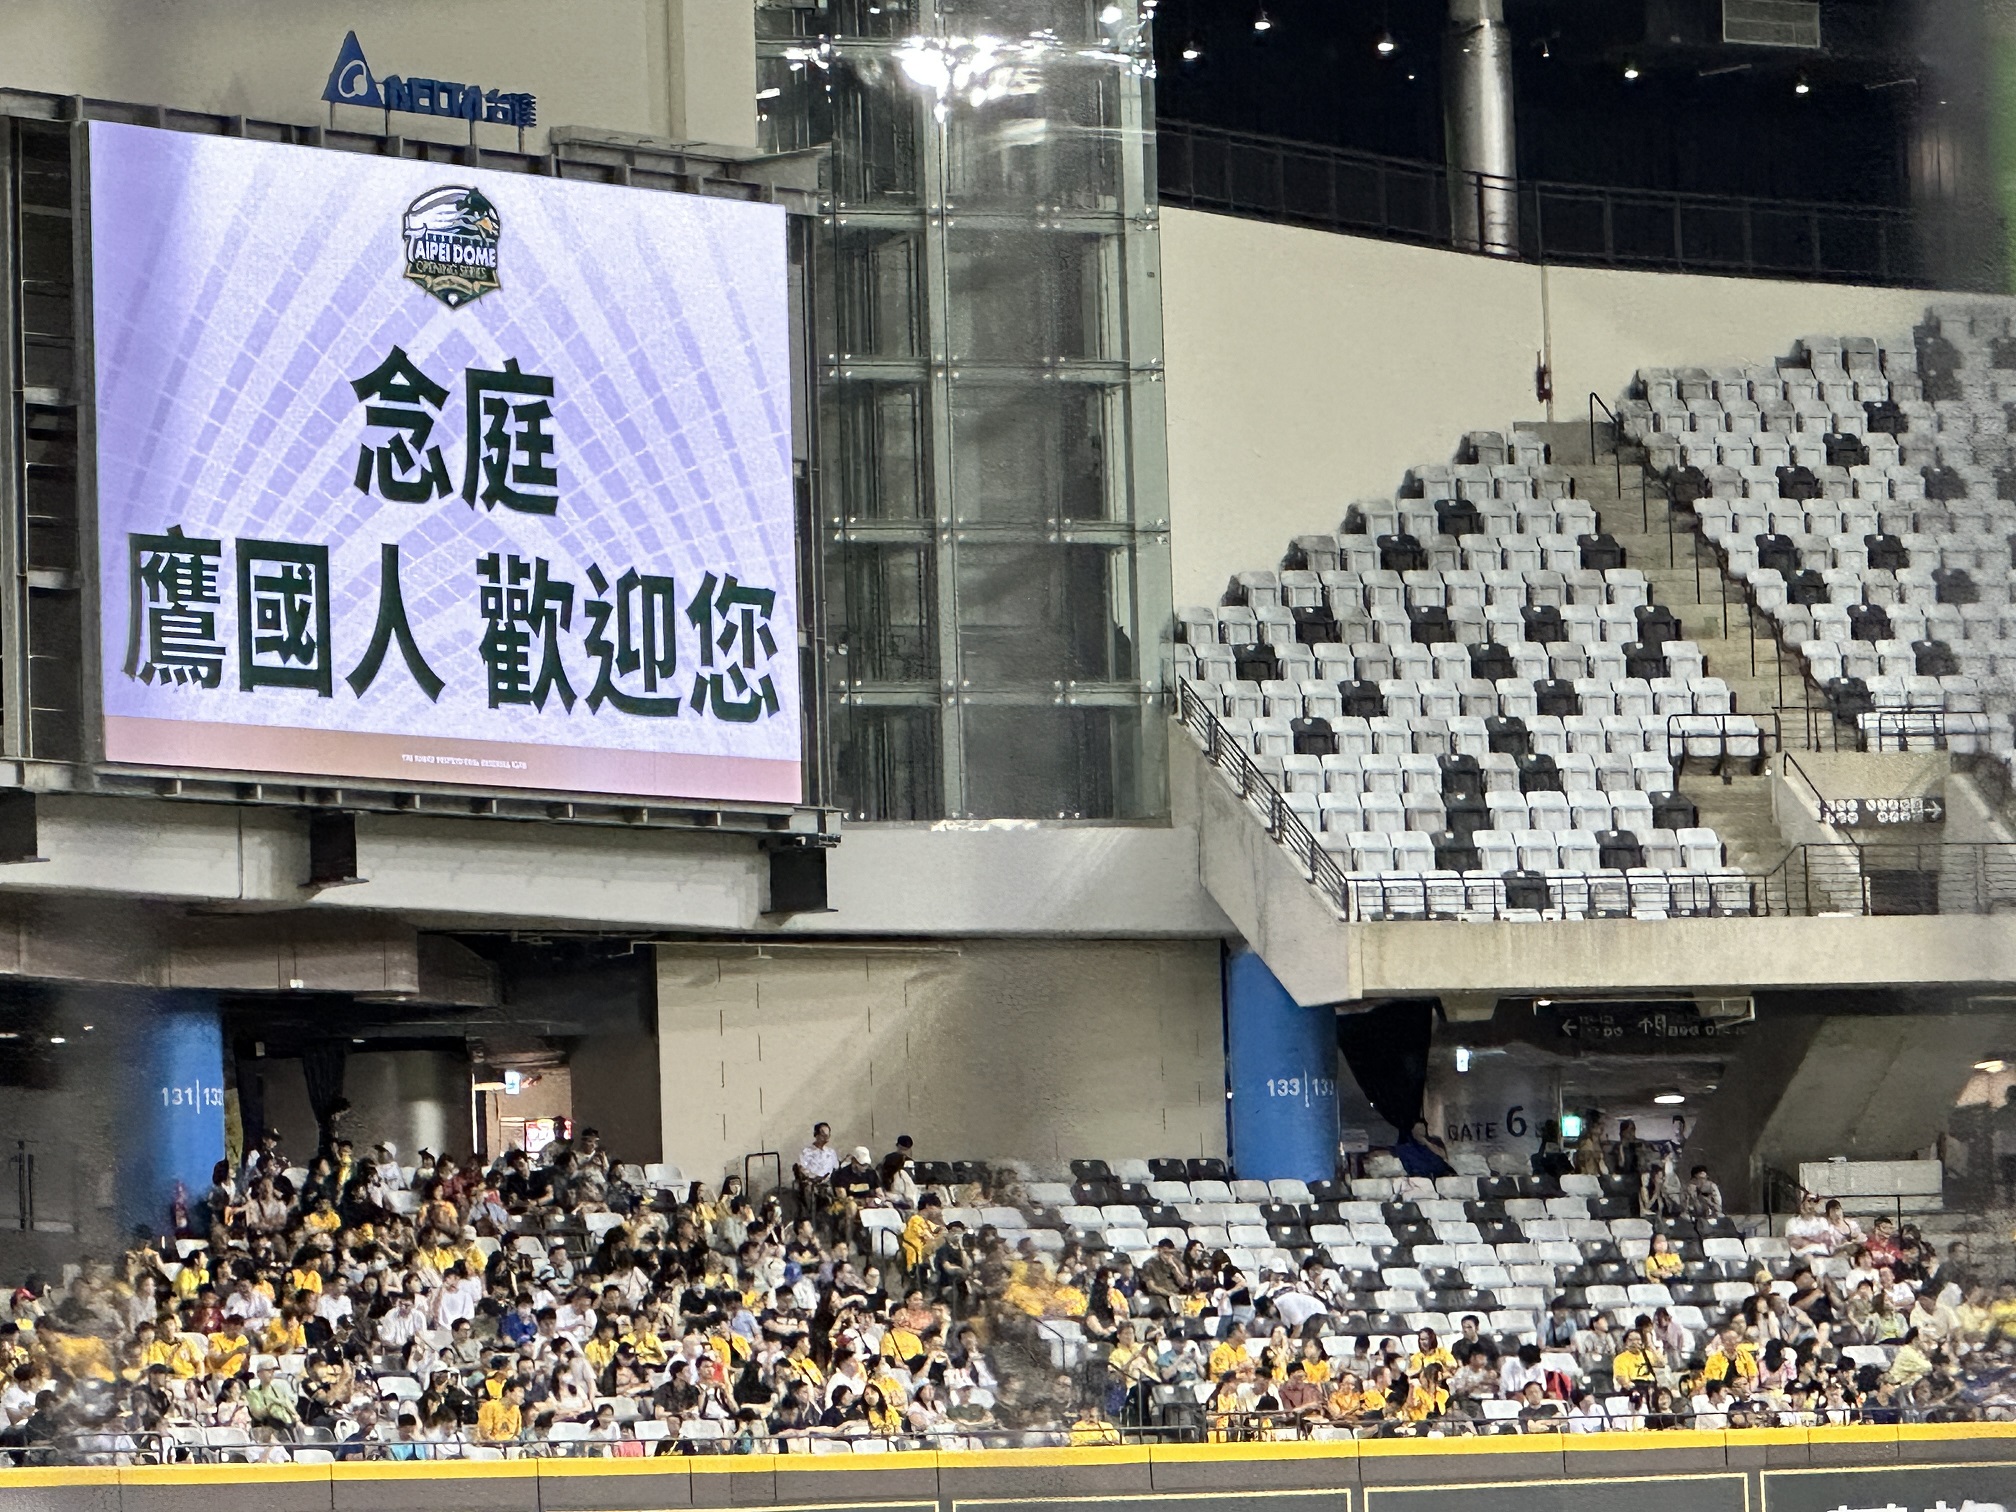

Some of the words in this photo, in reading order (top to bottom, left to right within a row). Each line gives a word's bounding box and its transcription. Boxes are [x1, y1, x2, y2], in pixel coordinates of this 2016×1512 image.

[404, 228, 451, 263] TAIPEI
[452, 244, 497, 268] DOME
[350, 344, 559, 517] 念庭
[122, 524, 445, 704] 鷹國人
[476, 551, 781, 723] 歡迎您
[162, 1087, 193, 1107] 131
[1266, 1078, 1301, 1097] 133
[1506, 1106, 1527, 1138] 6
